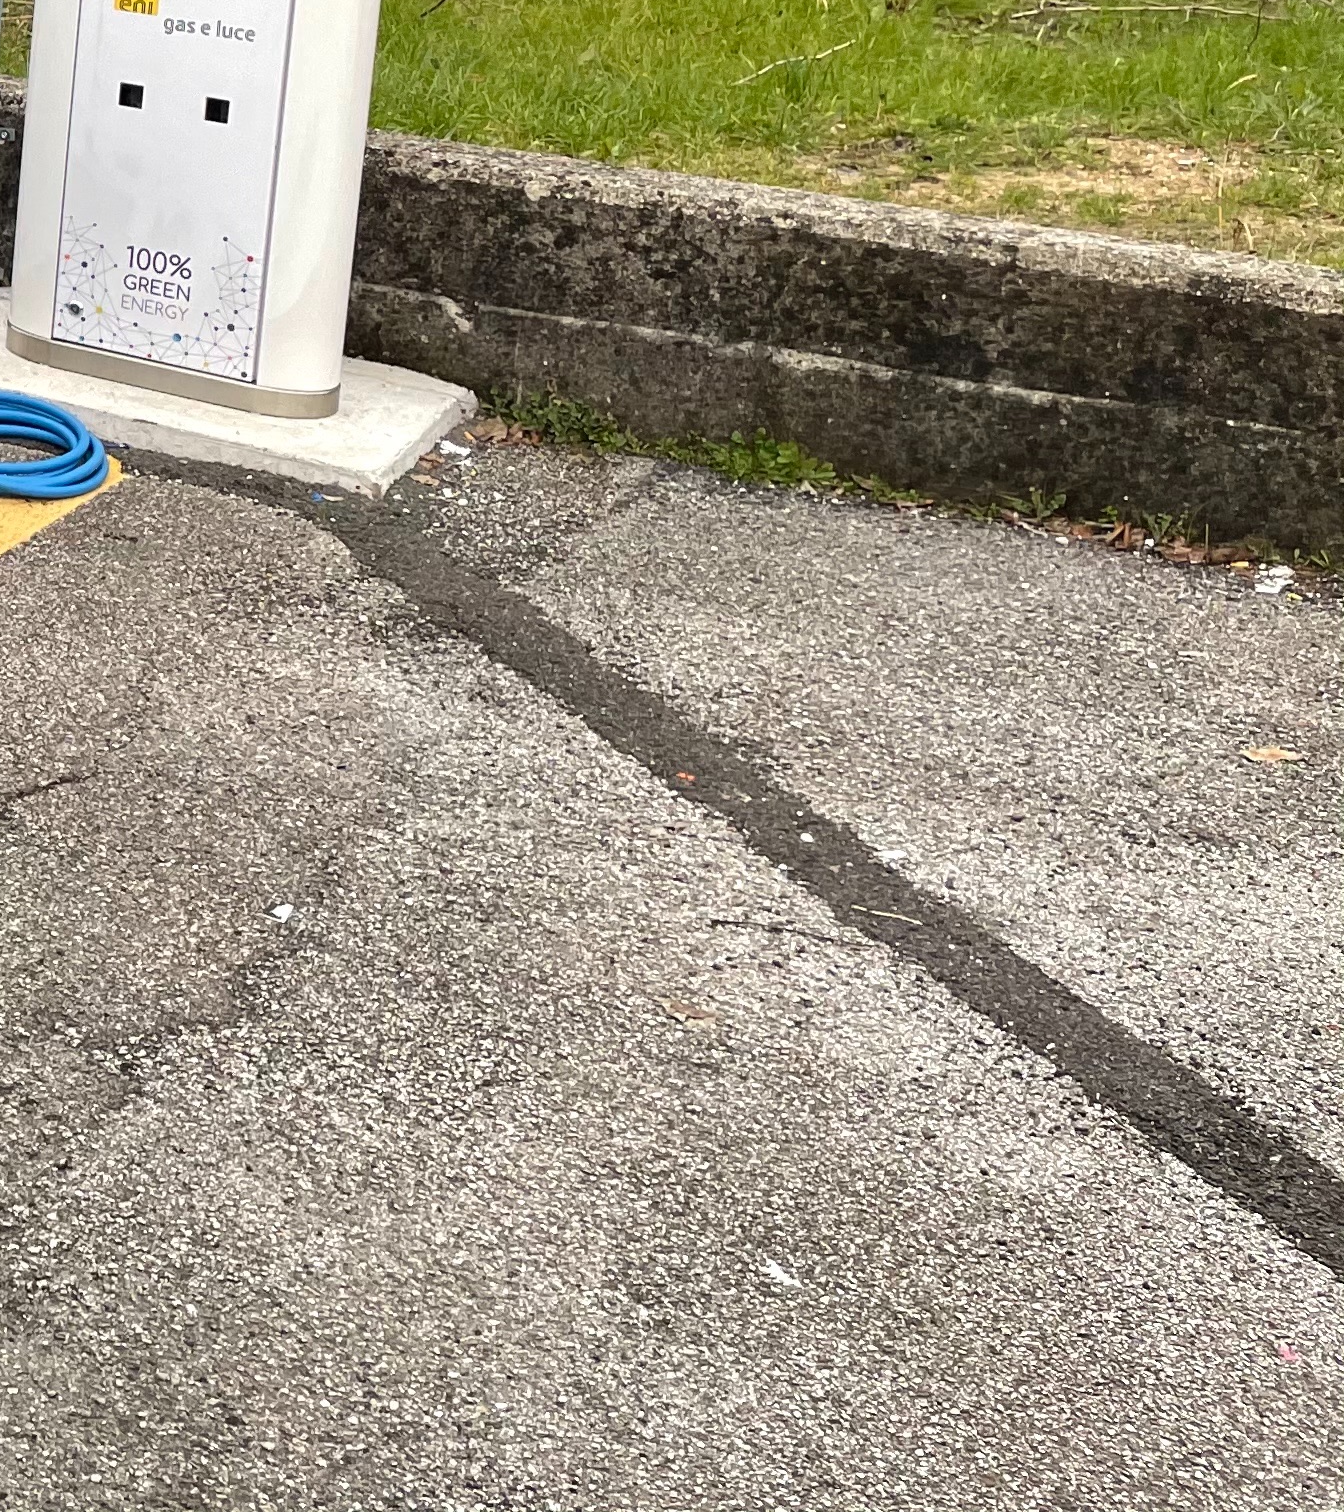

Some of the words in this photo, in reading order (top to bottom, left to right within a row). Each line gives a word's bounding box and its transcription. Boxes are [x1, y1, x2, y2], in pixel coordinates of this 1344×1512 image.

[164, 18, 196, 38] gas
[200, 21, 212, 34] e
[216, 18, 255, 42] luce
[126, 245, 192, 279] 100%
[123, 274, 191, 302] GREEN
[120, 295, 189, 322] ENERGY
